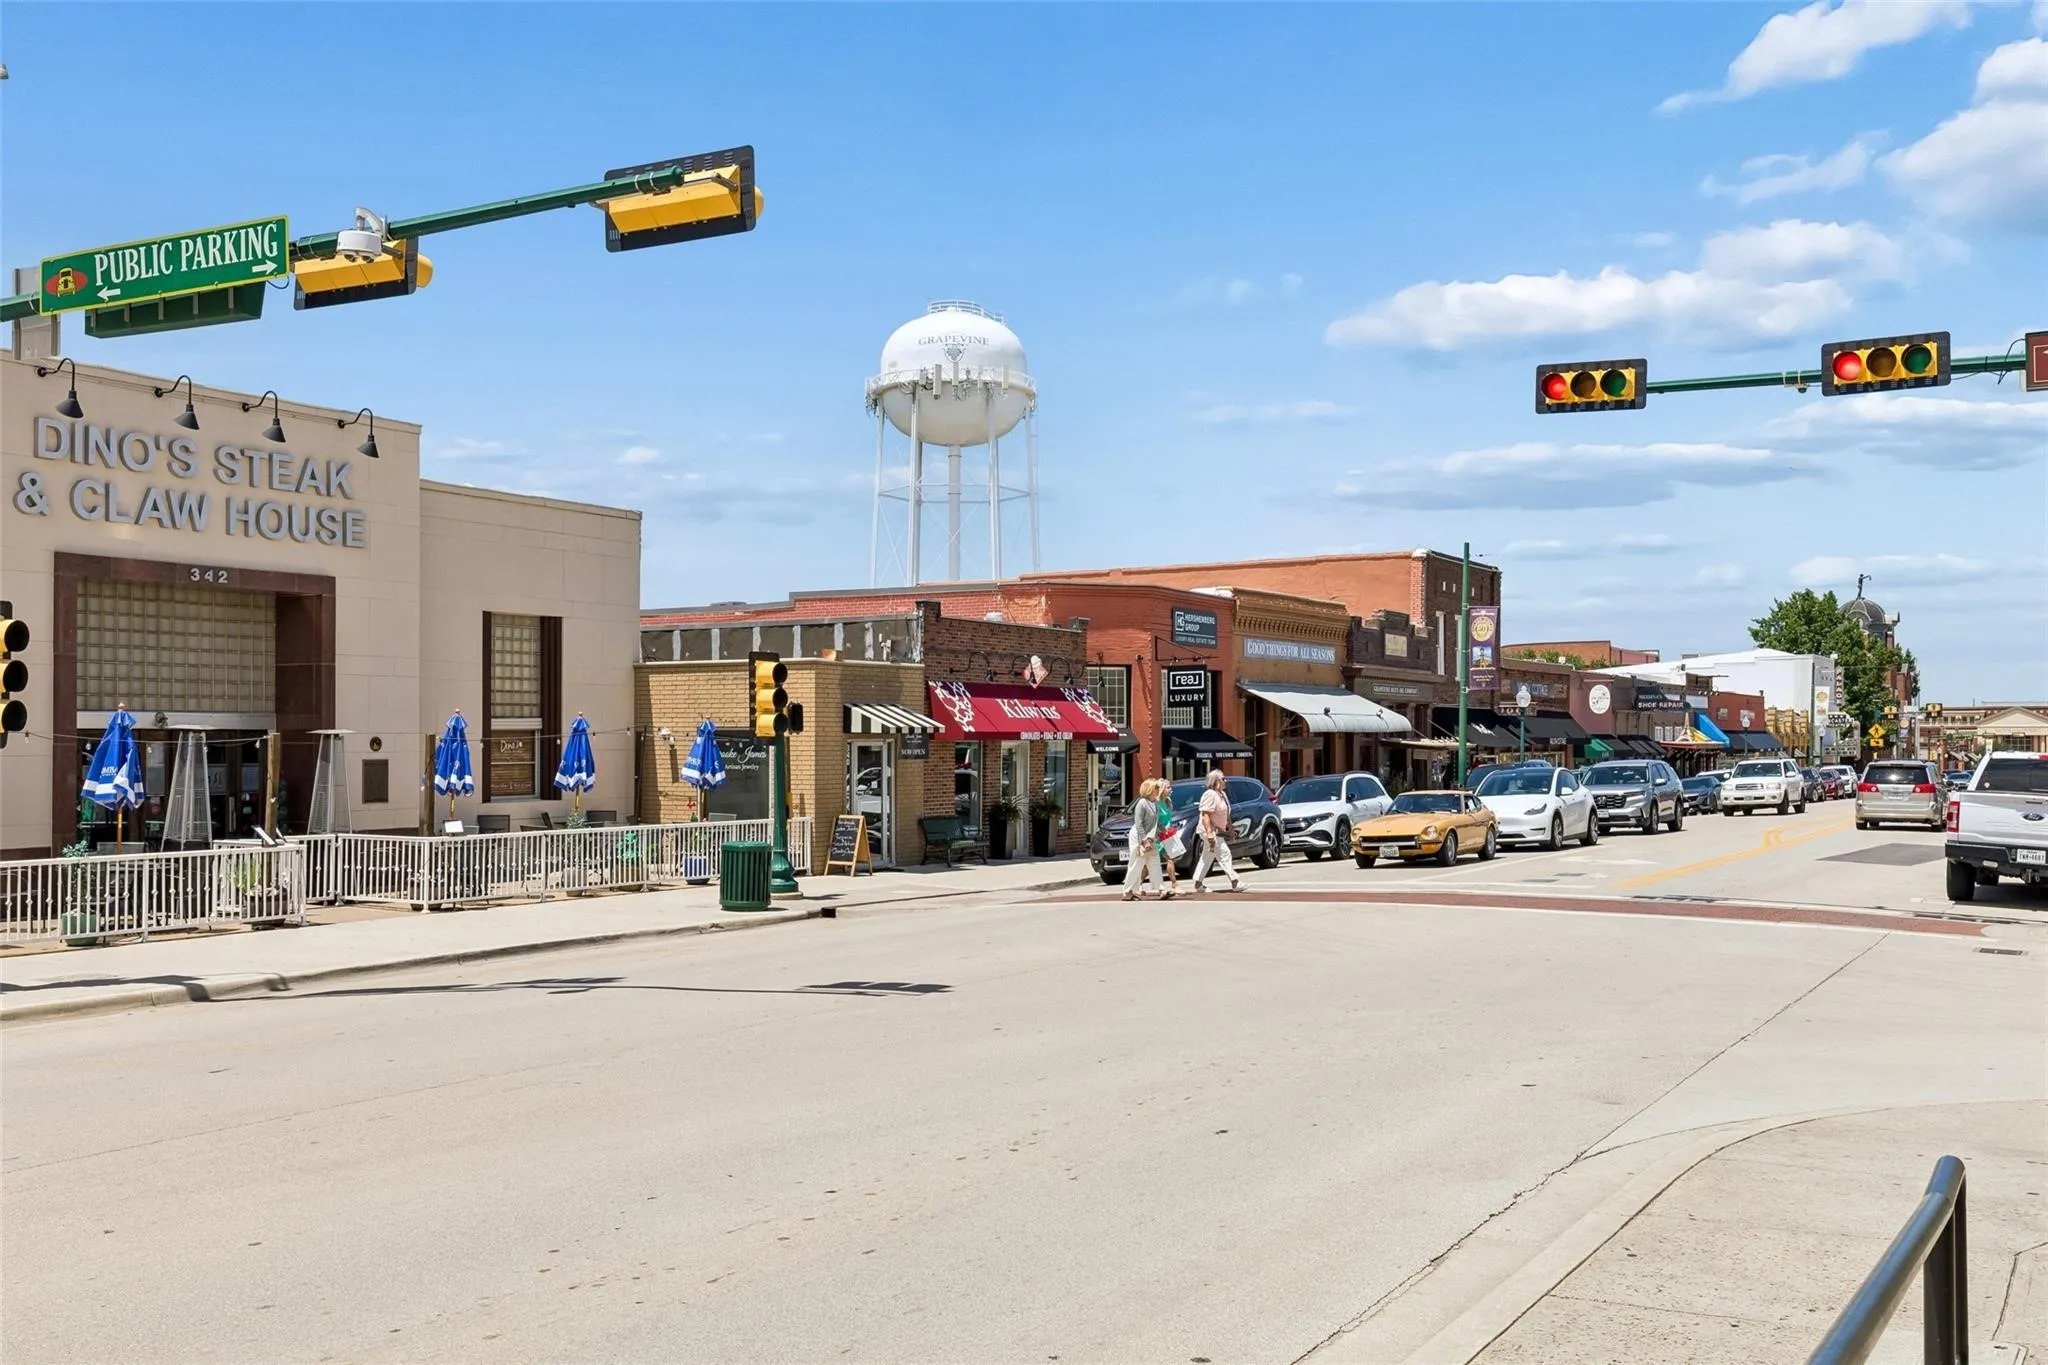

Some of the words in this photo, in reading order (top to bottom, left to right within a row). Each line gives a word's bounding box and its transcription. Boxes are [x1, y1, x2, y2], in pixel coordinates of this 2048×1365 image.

[94, 243, 173, 286] PUBLIC
[180, 224, 278, 271] PARKING
[918, 335, 990, 346] GRAPEVINE
[34, 416, 198, 478] DINO'S
[213, 445, 353, 499] STEAK
[14, 472, 49, 516] &
[70, 479, 208, 532] CLAW
[225, 497, 369, 548] HOUSE
[190, 568, 228, 584] 342
[1184, 623, 1200, 632] GROUP
[1247, 642, 1265, 655] GOOD
[1266, 643, 1287, 657] THINGS
[1287, 645, 1299, 658] FOR
[1300, 646, 1310, 659] ALL
[1311, 647, 1335, 661] SEASONS
[1170, 694, 1204, 702] LUXURY
[996, 699, 1061, 719] Kilwins
[737, 745, 767, 764] James
